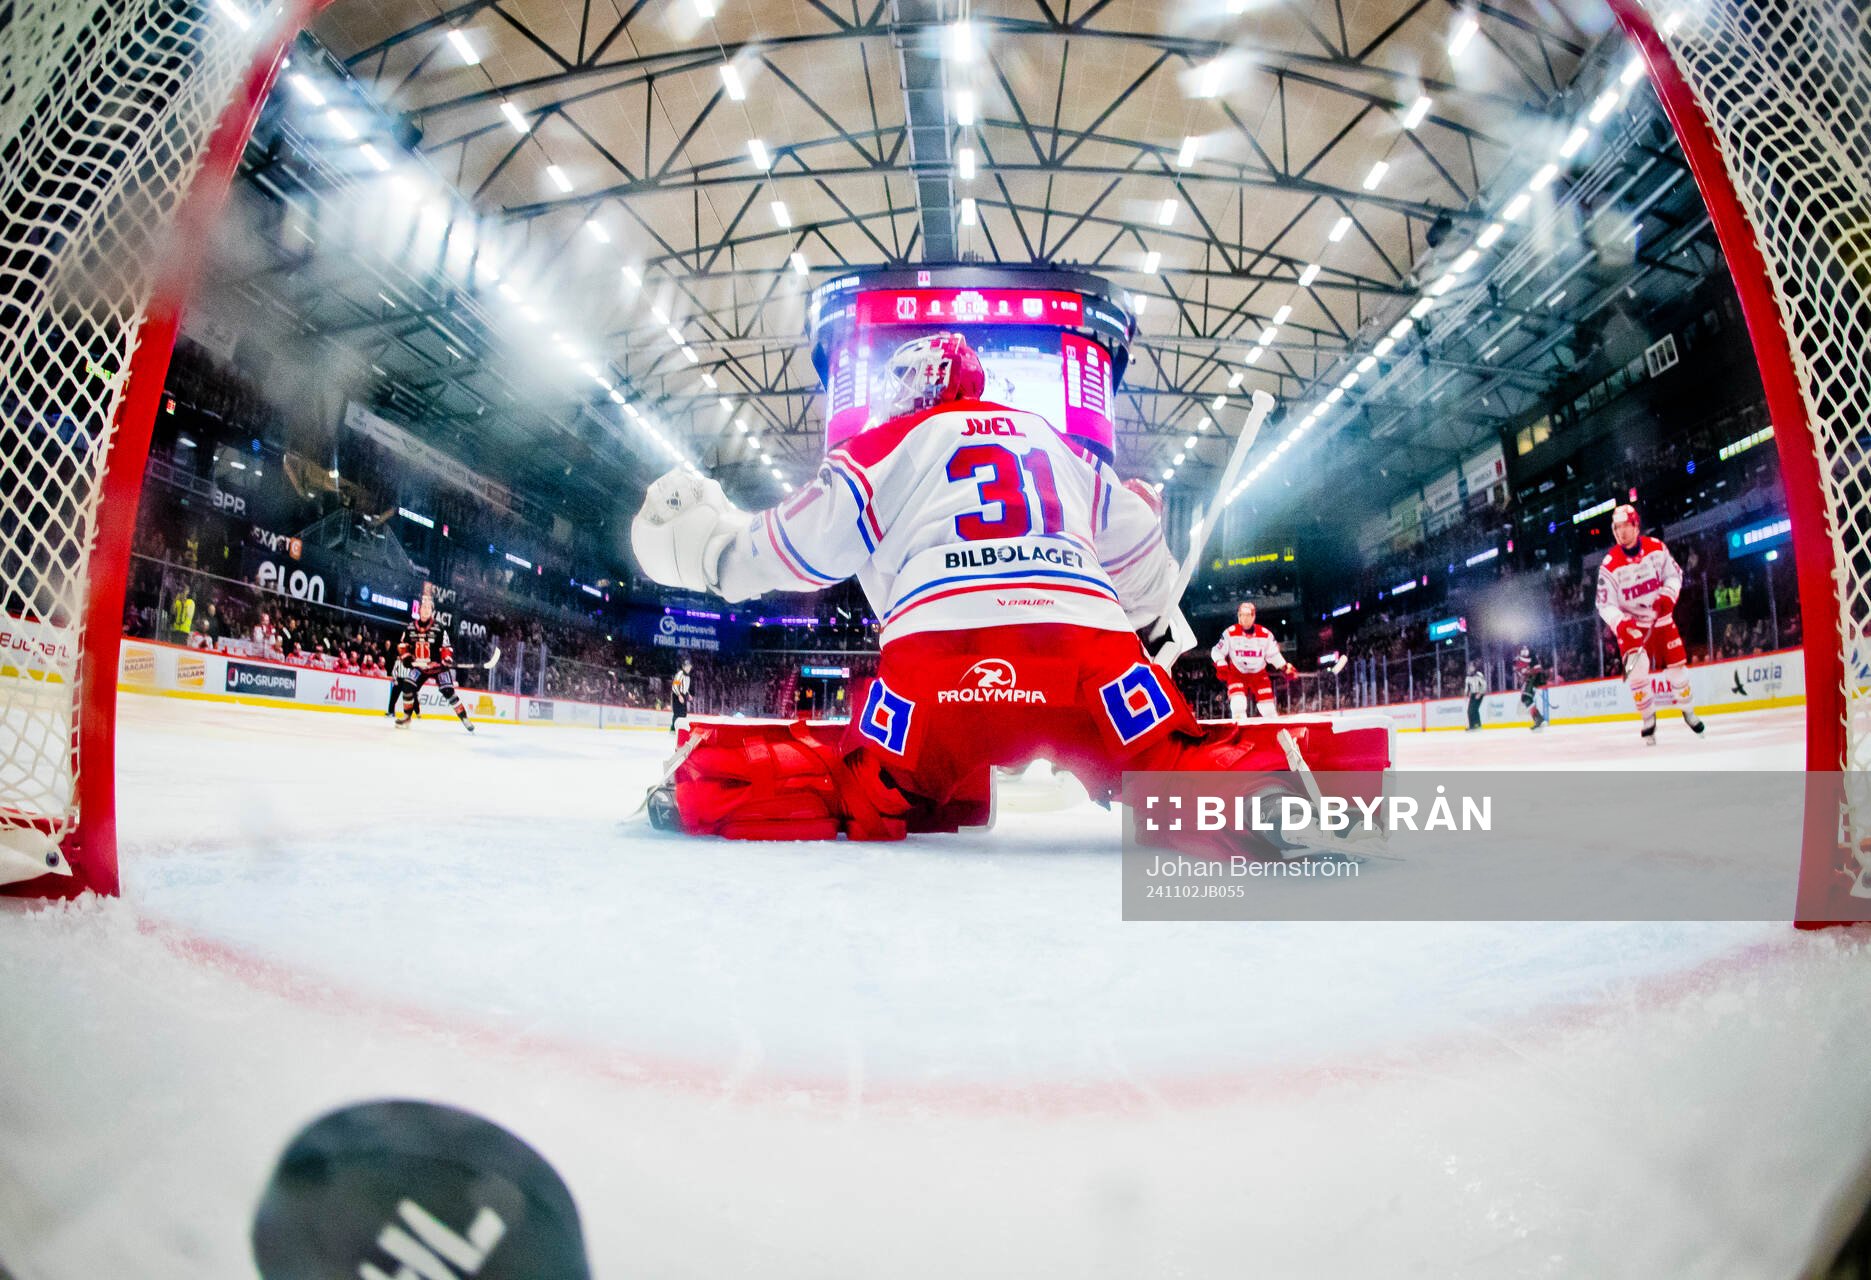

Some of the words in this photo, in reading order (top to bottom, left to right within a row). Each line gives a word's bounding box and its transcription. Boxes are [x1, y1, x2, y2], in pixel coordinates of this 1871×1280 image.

[961, 417, 1026, 437] JUEL
[945, 443, 1064, 541] 31
[945, 545, 1083, 569] BILBOLAGET
[258, 561, 325, 603] elon
[240, 672, 296, 689] RO-GRUPPEN
[1746, 662, 1782, 683] Loxia
[937, 687, 1047, 704] PROLYMPIA
